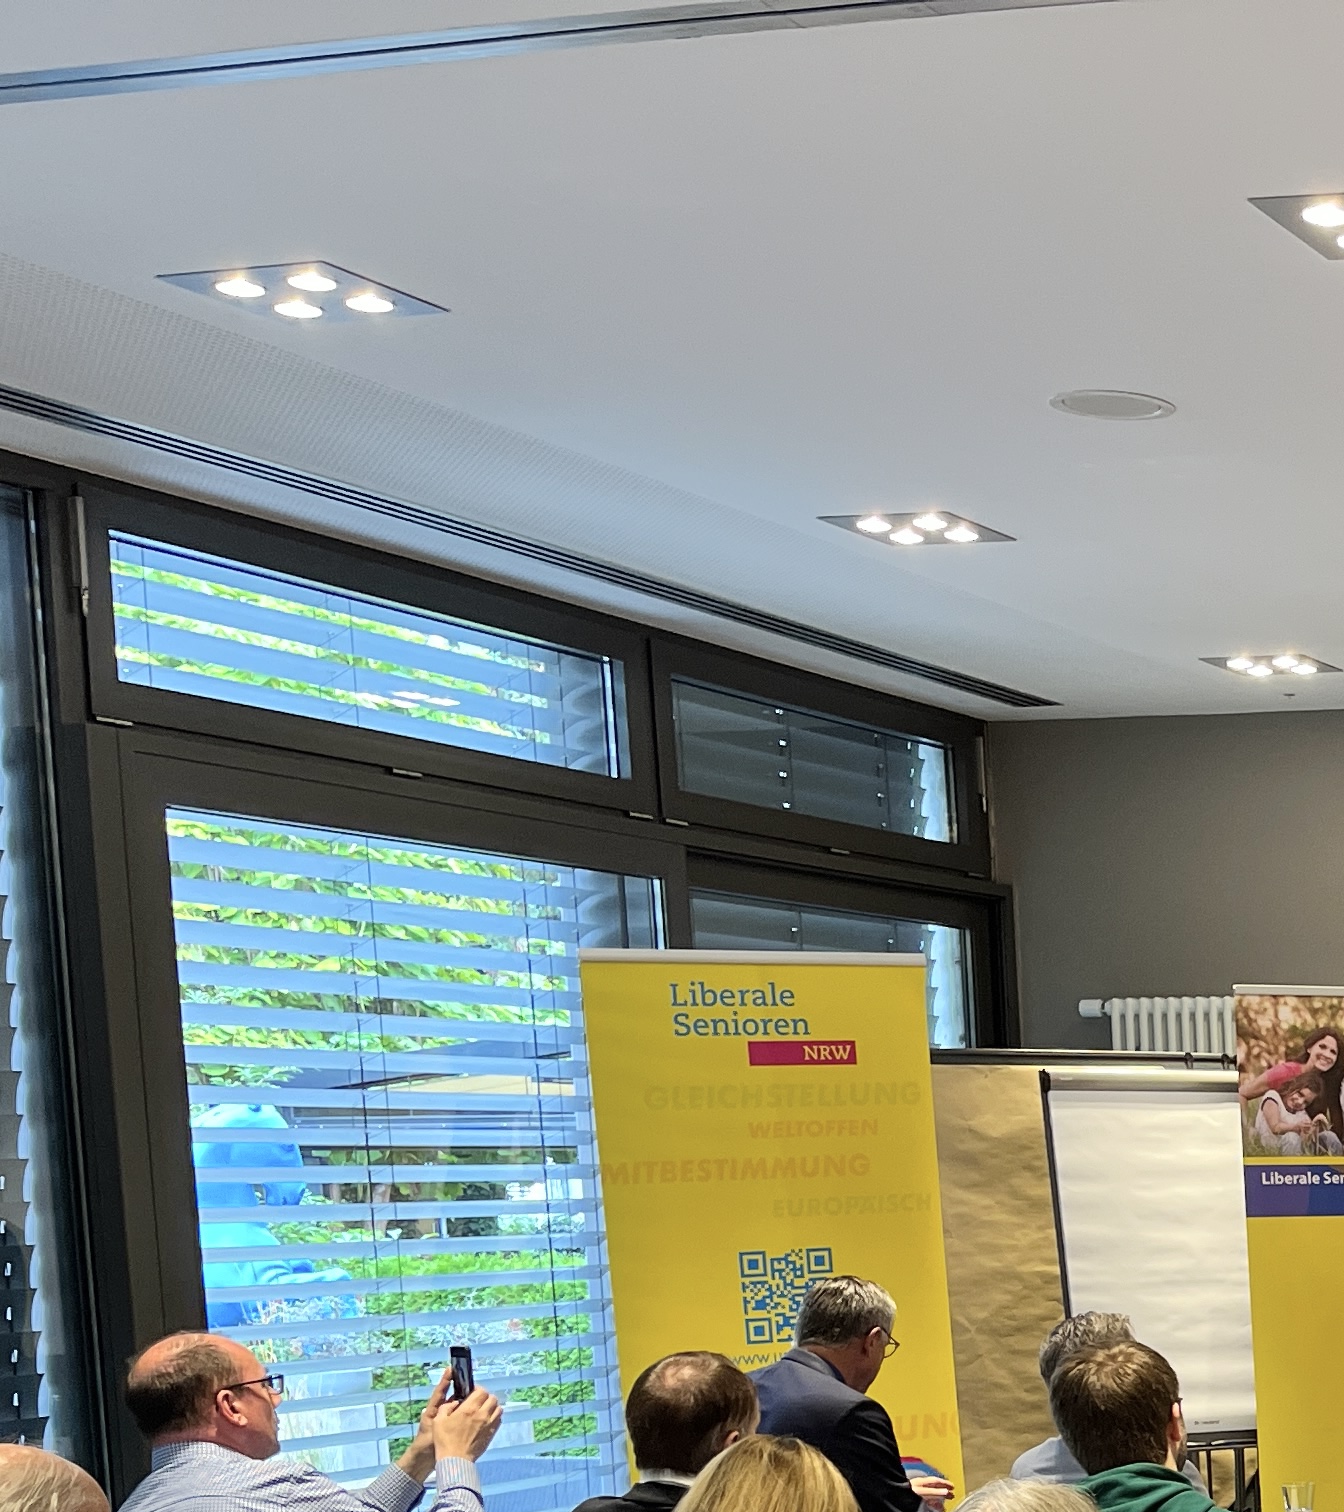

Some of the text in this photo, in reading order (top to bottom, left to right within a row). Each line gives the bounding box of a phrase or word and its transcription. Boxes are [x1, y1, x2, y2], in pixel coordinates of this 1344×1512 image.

[670, 981, 796, 1009] Liberale
[672, 1010, 811, 1038] Senioren
[802, 1043, 852, 1062] NRW
[643, 1081, 922, 1111] GLEICHSTELLUNG
[748, 1118, 879, 1139] WELTOFFEN
[602, 1153, 871, 1185] MITBESTIMMUNG
[1261, 1170, 1321, 1186] Liberale
